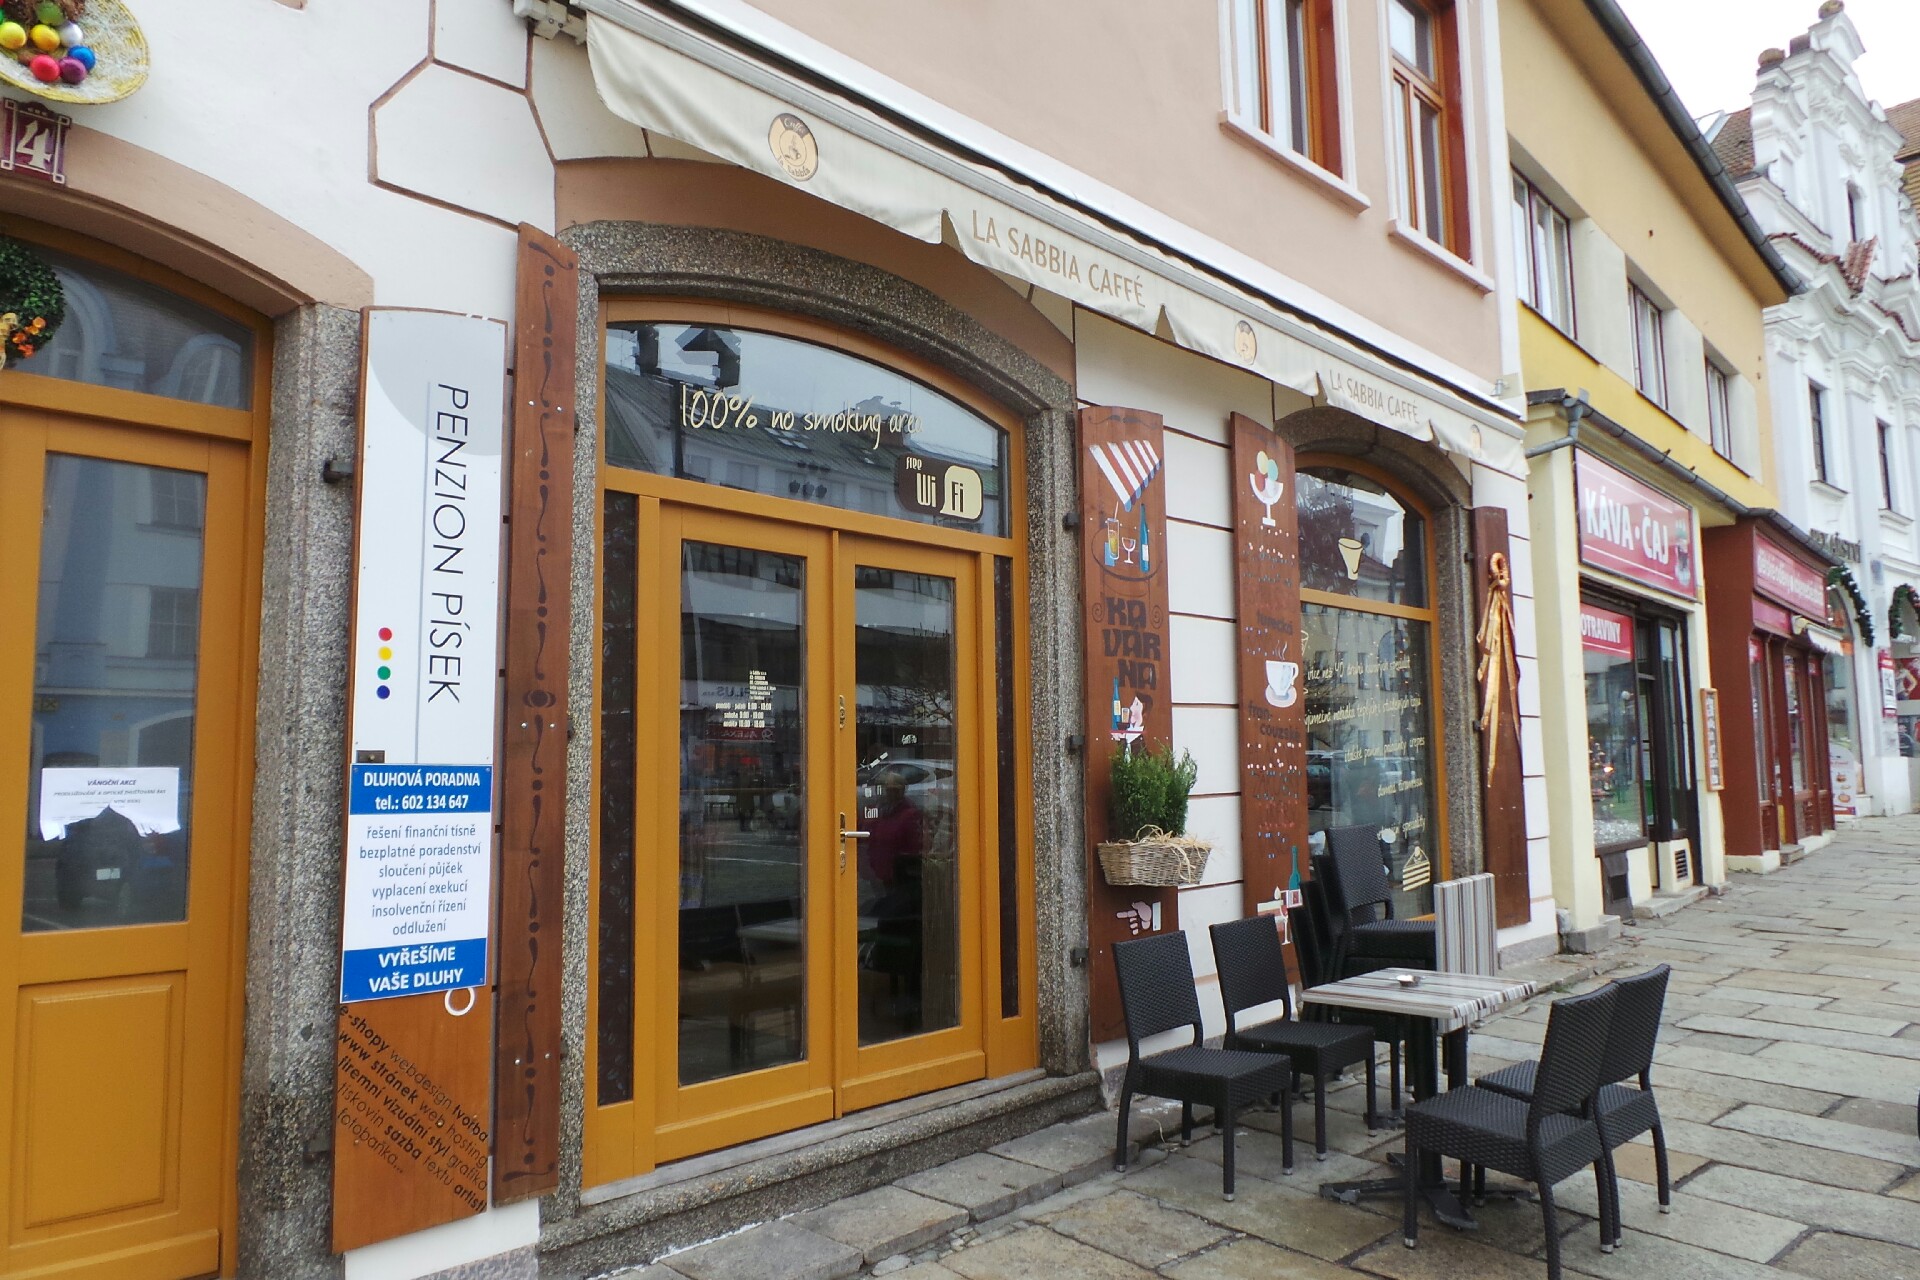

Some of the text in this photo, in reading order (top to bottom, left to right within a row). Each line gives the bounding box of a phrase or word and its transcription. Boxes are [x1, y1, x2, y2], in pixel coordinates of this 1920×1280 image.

[16, 120, 53, 170] 4
[972, 209, 1146, 308] LA SABBIA CAFFÉ
[1329, 369, 1420, 424] LA SABBIA CAFFÉ
[680, 384, 925, 450] 100% no smoking area
[905, 456, 922, 471] free
[1584, 487, 1669, 565] KÁVA ČAJ
[428, 384, 470, 704] PENZION PÍSEK
[1580, 613, 1621, 643] OTRAVINY
[364, 769, 481, 787] DLUHOVÁ PORADNA
[375, 794, 469, 810] tel.: 602 134 647
[864, 806, 879, 820] tam
[366, 824, 476, 839] řešení finanční tísně
[360, 842, 481, 863] bezplatné poradenství
[379, 862, 463, 881] sloučení půjček
[372, 879, 468, 900] vyplacení exekucí
[372, 898, 466, 918] insolvenční řízení
[392, 918, 446, 936] oddlužení
[378, 945, 456, 968] VYŘEŠÍME
[369, 967, 463, 993] VAŠE DLUHY
[340, 1004, 489, 1142] e-shopy webdesign tvorba
[338, 1030, 488, 1168] www stránek web hosting
[337, 1082, 384, 1128] tiskovin
[423, 1155, 453, 1186] textu
[338, 1056, 488, 1191] firemní vizuální styl grafika
